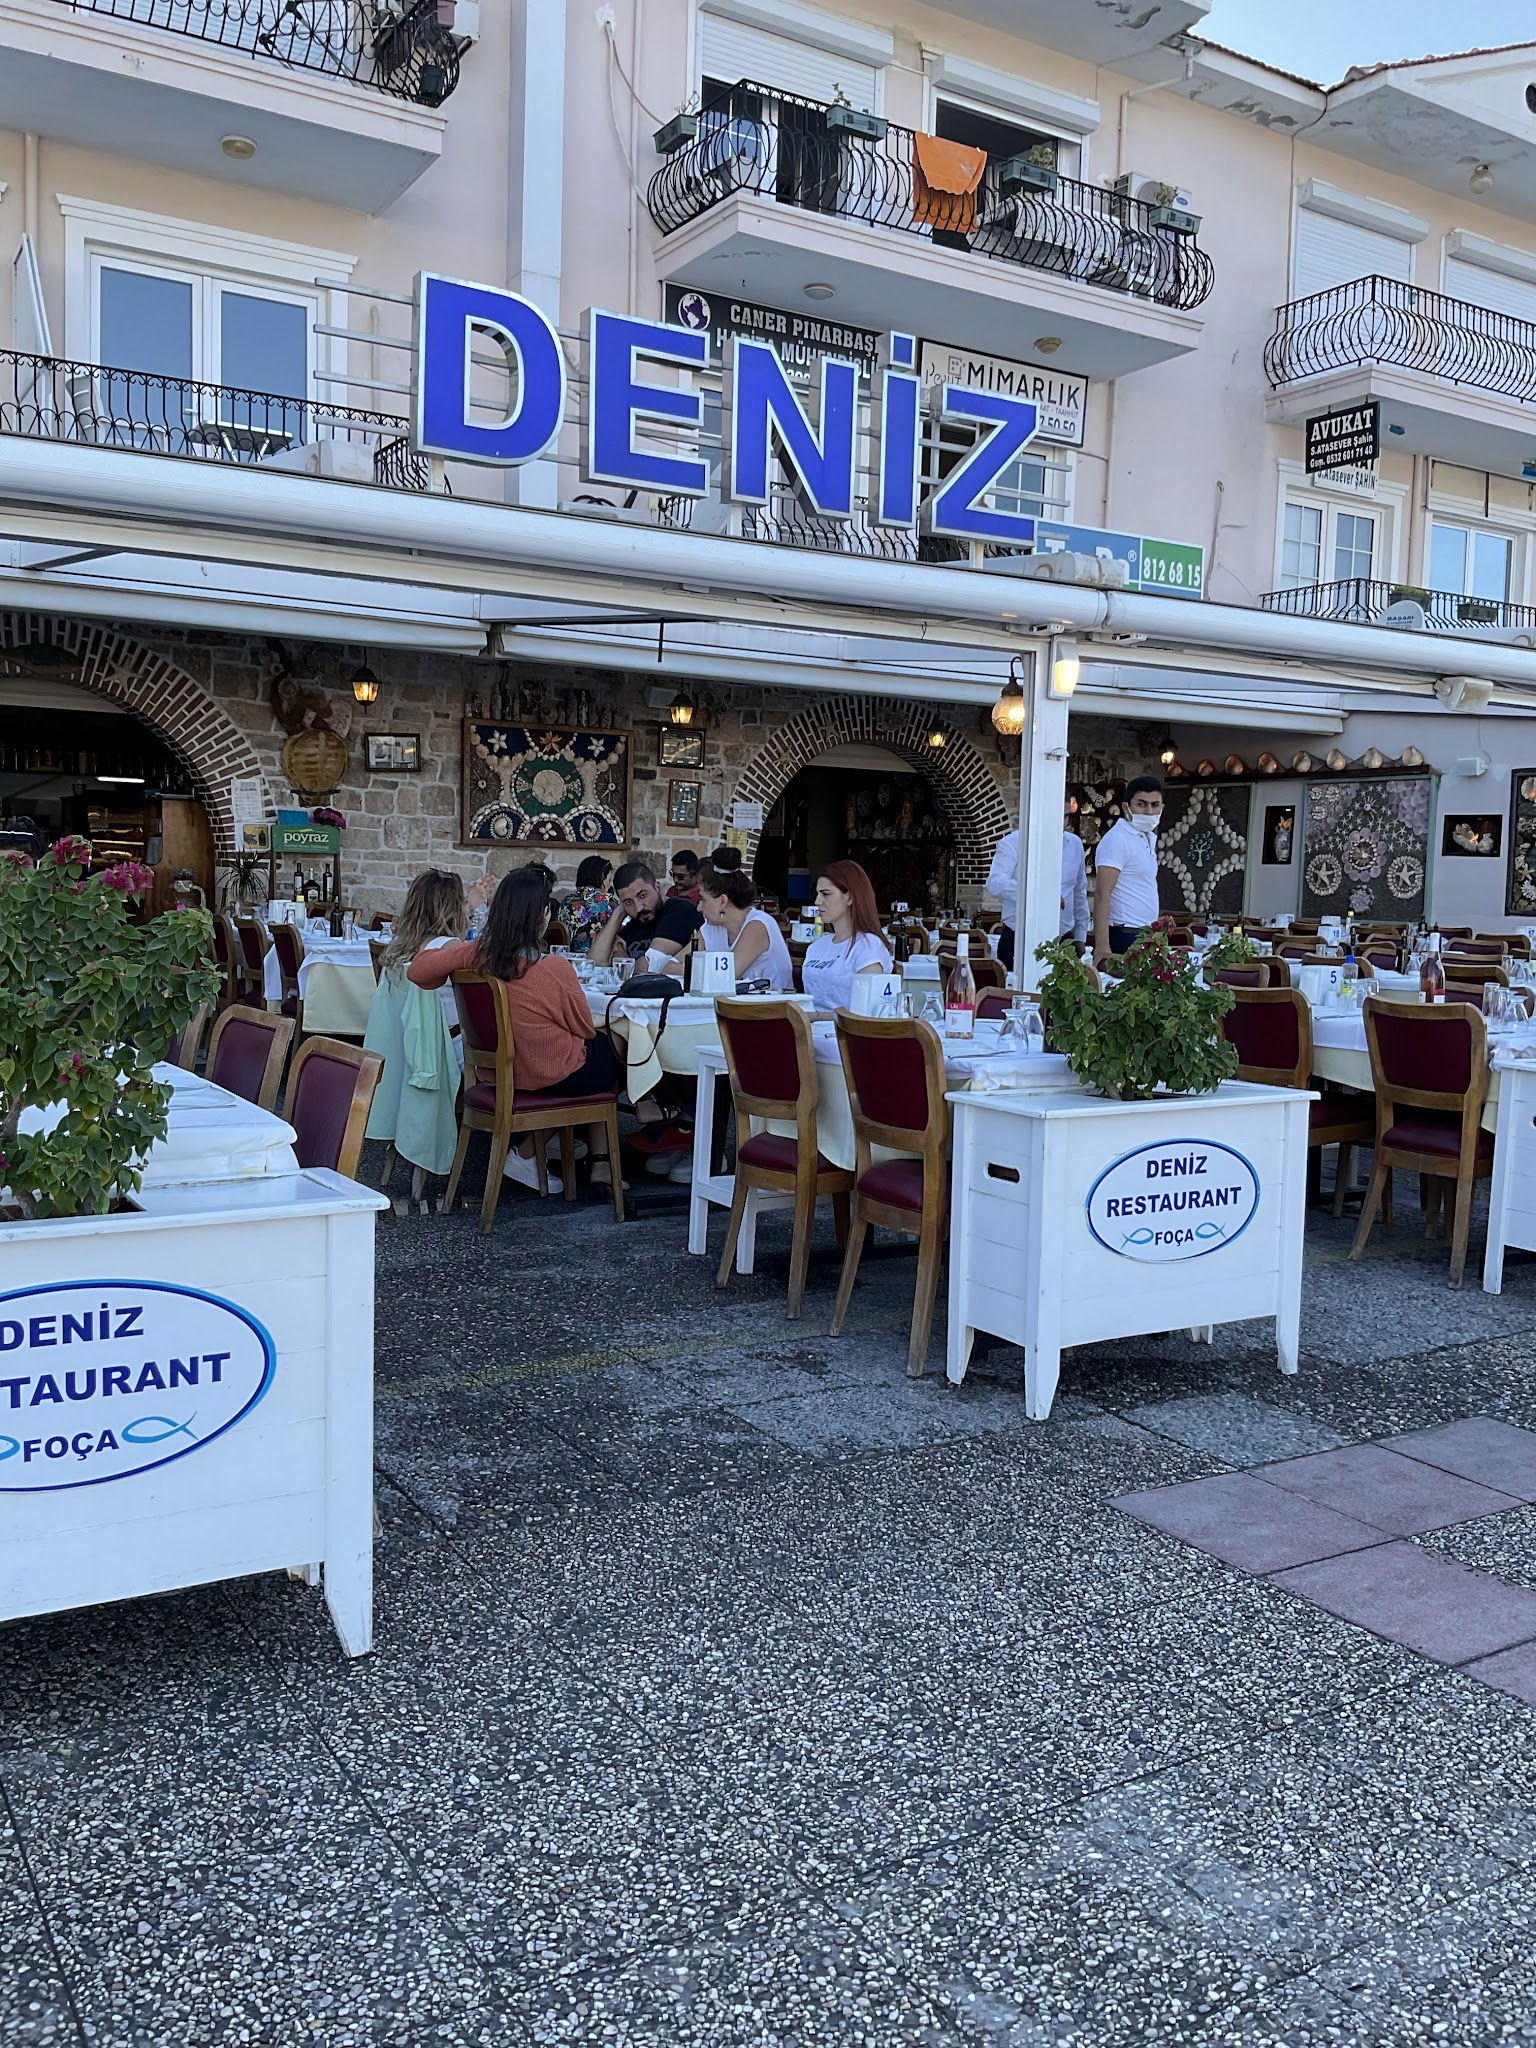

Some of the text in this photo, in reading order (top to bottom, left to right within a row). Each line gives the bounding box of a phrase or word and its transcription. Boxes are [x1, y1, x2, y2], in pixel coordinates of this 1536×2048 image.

[730, 304, 787, 334] CANER
[967, 361, 1080, 410] MİMARLIK
[414, 270, 1039, 548] DENİZ
[1310, 408, 1374, 442] AVUKAT
[1310, 432, 1373, 456] S.ATASEVER Şahin
[1326, 451, 1342, 465] 0532
[1342, 448, 1354, 461] 601
[1355, 446, 1363, 459] 71
[1364, 444, 1373, 455] 40
[1143, 556, 1165, 582] 812
[1169, 561, 1183, 584] 68
[1187, 564, 1200, 587] 15
[283, 832, 330, 845] poyraz
[715, 956, 728, 971] 13
[1330, 970, 1337, 984] 5
[882, 981, 893, 996] 4
[1146, 1152, 1208, 1179] DENİZ
[1106, 1186, 1242, 1218] RESTAURANT
[1154, 1228, 1194, 1247] FOÇA
[0, 1302, 144, 1351] DENİZ
[0, 1351, 231, 1409] TAURANT
[23, 1429, 120, 1463] FOÇA
